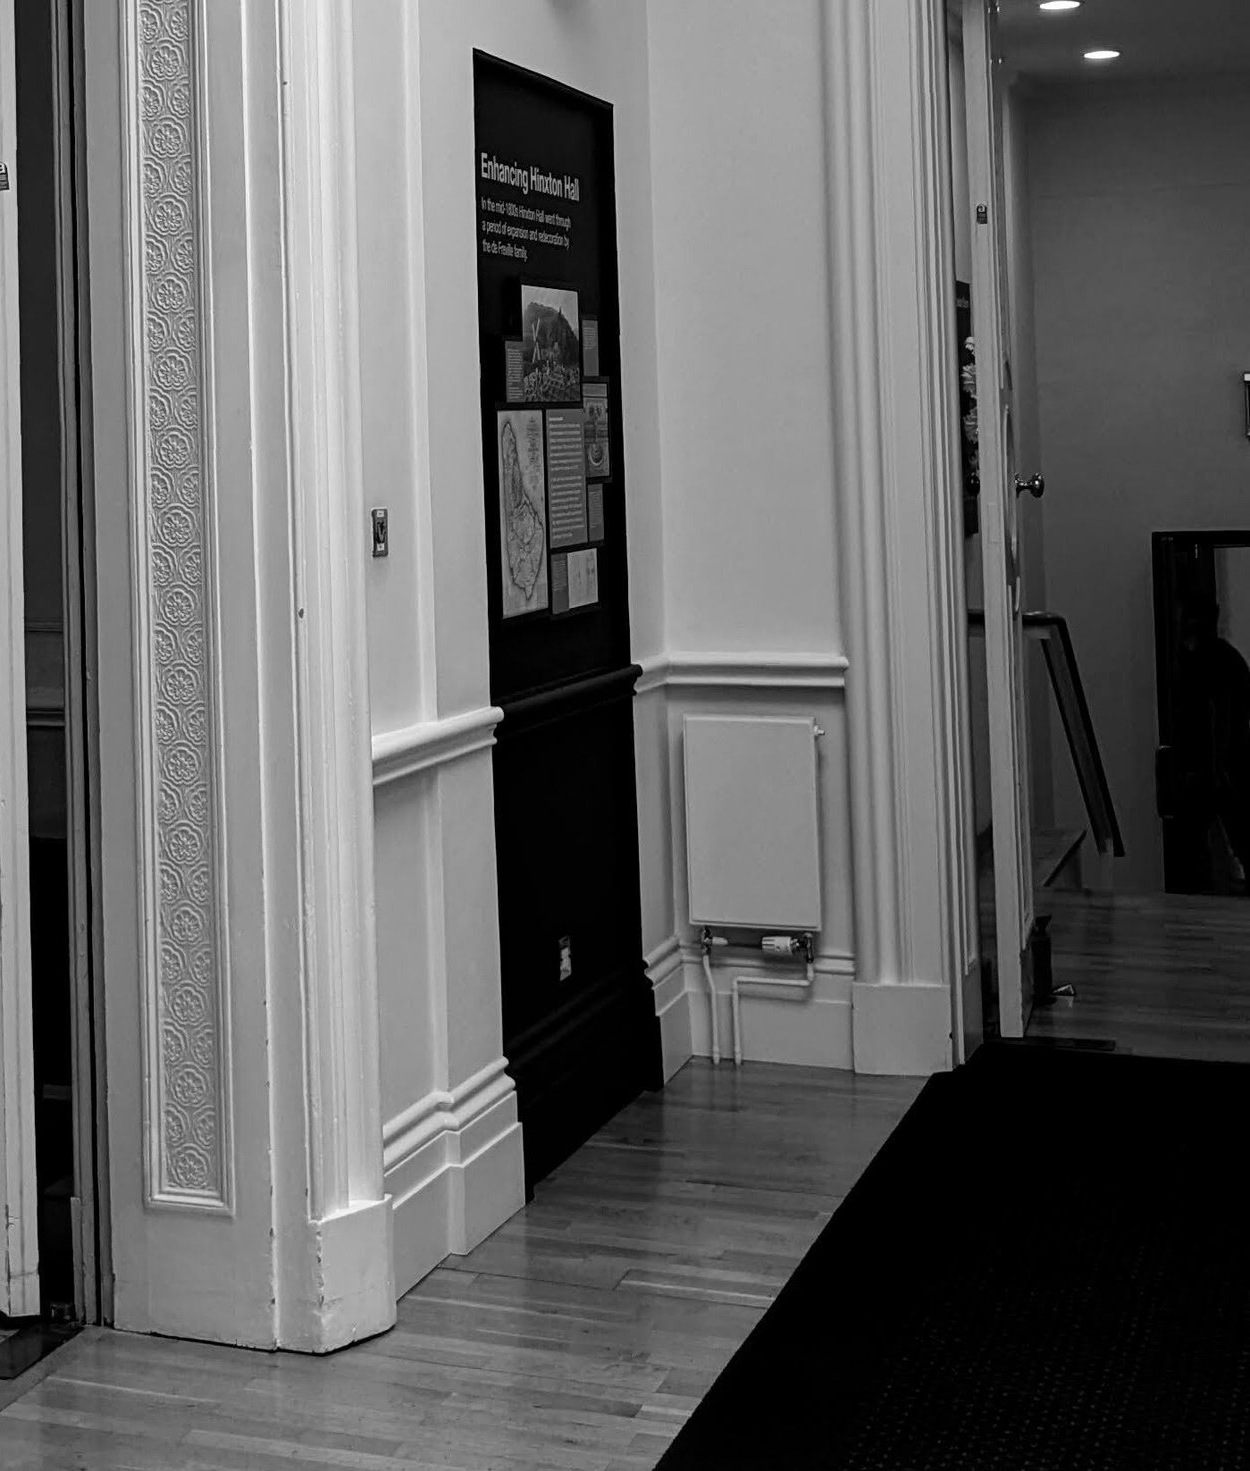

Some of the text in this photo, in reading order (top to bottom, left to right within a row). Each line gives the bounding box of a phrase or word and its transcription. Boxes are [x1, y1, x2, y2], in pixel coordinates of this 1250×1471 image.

[481, 152, 580, 202] Enhancing Hinxton Hall
